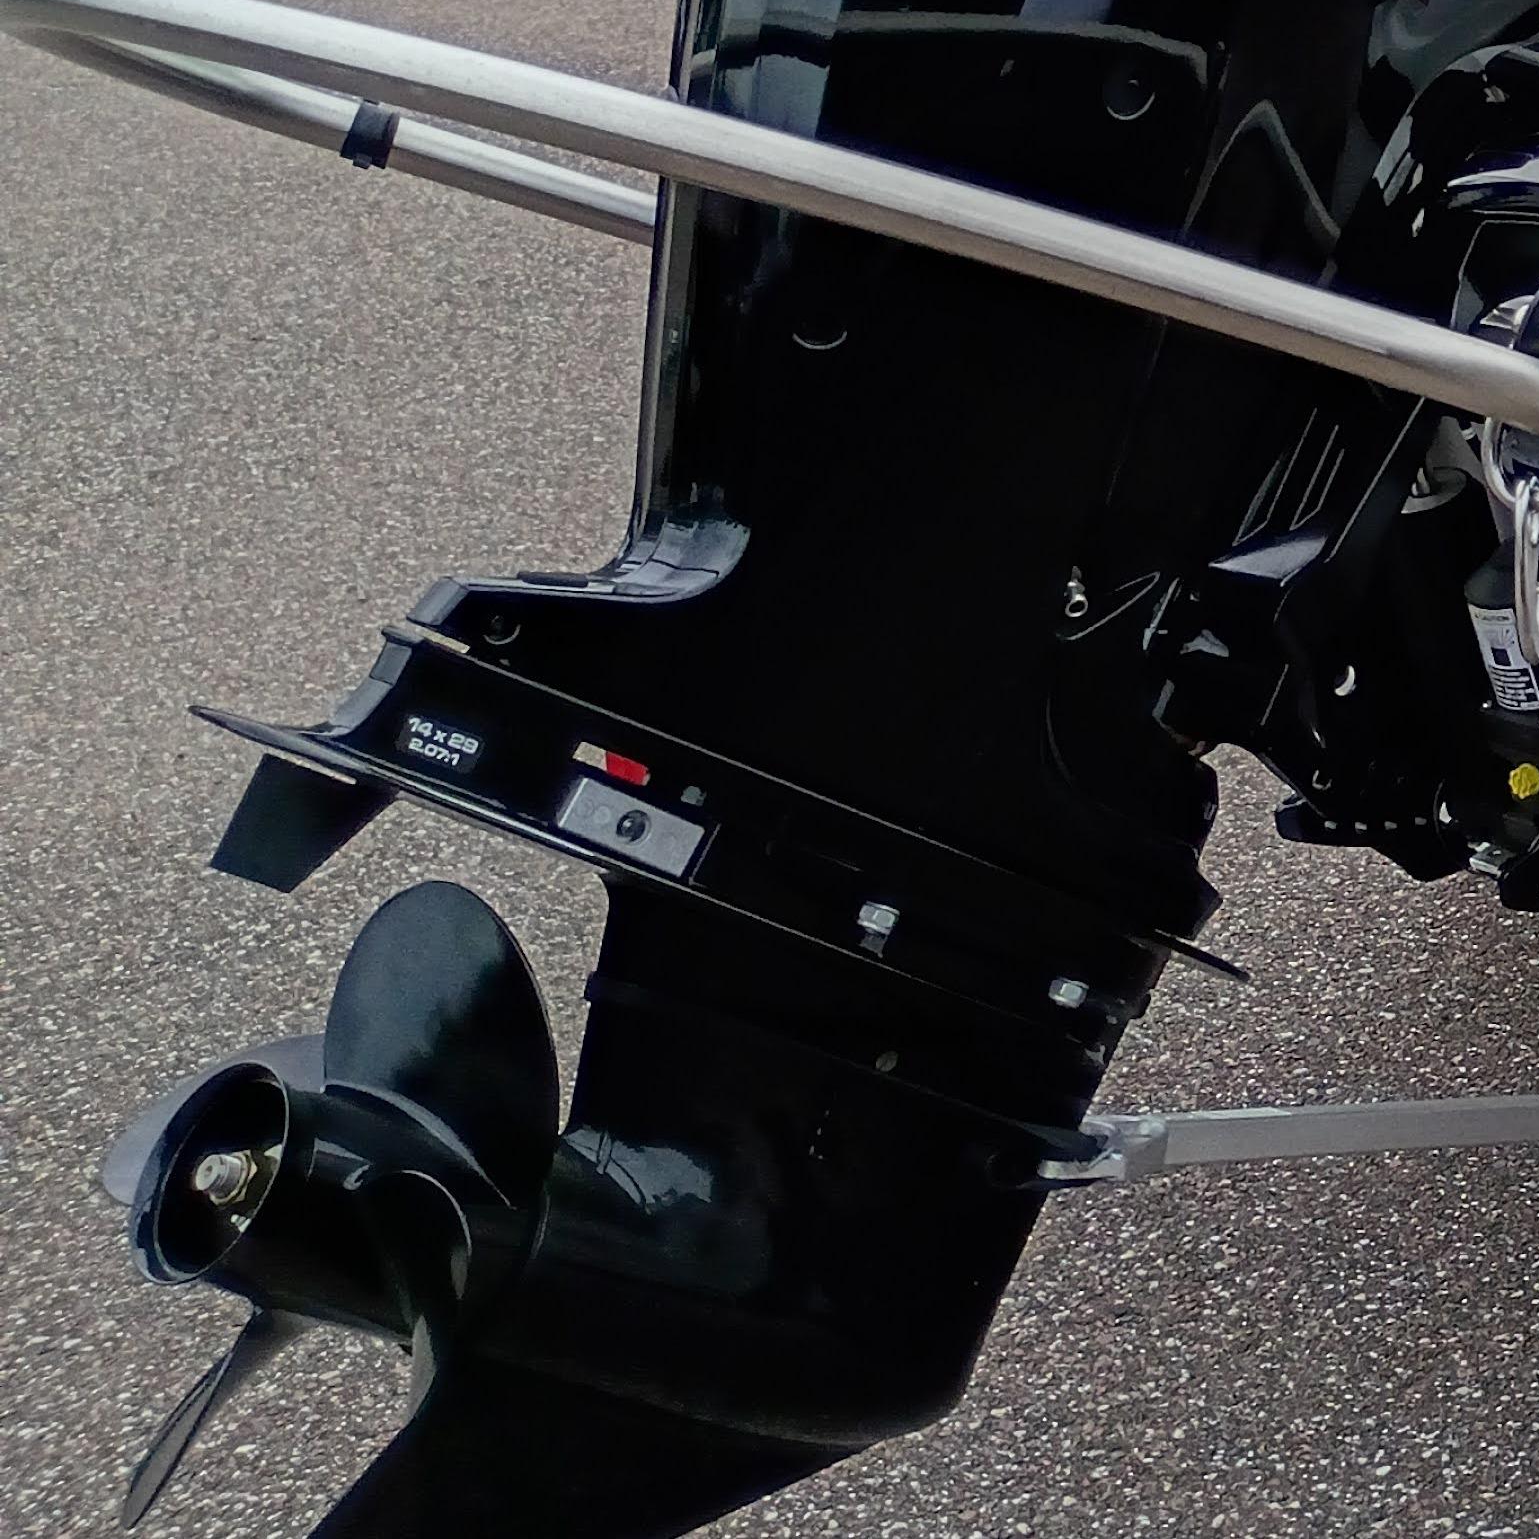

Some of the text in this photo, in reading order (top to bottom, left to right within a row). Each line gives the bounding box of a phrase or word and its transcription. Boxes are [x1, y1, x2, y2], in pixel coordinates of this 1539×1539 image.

[409, 717, 479, 755] 14 x 29
